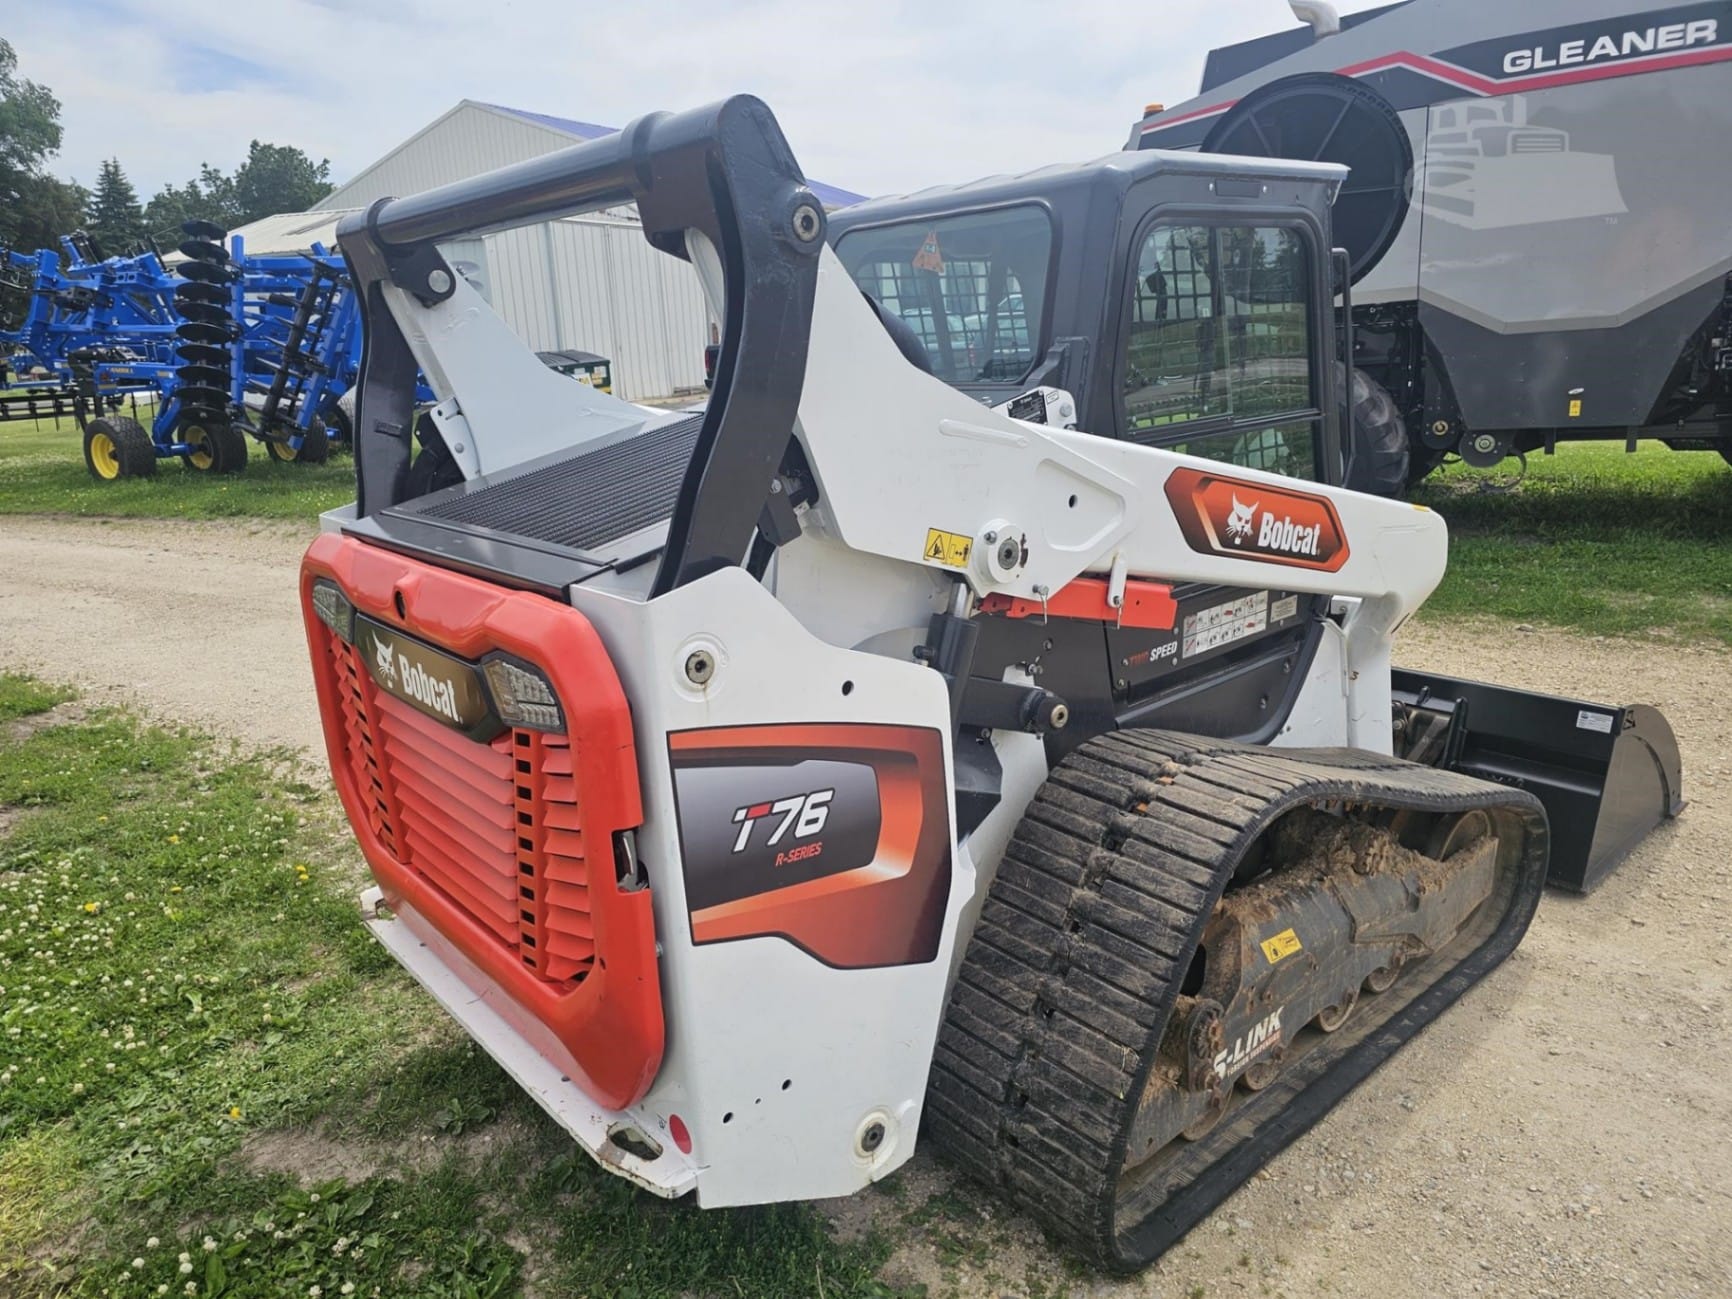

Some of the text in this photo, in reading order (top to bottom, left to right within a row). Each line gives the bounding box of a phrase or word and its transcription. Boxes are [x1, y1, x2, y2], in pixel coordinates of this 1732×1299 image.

[1503, 19, 1718, 74] GLEANER
[1257, 511, 1321, 556] Bobcat
[1149, 640, 1178, 662] SPEED
[398, 653, 460, 722] Bobcat
[731, 788, 835, 854] T76
[775, 842, 823, 867] R-SERIES
